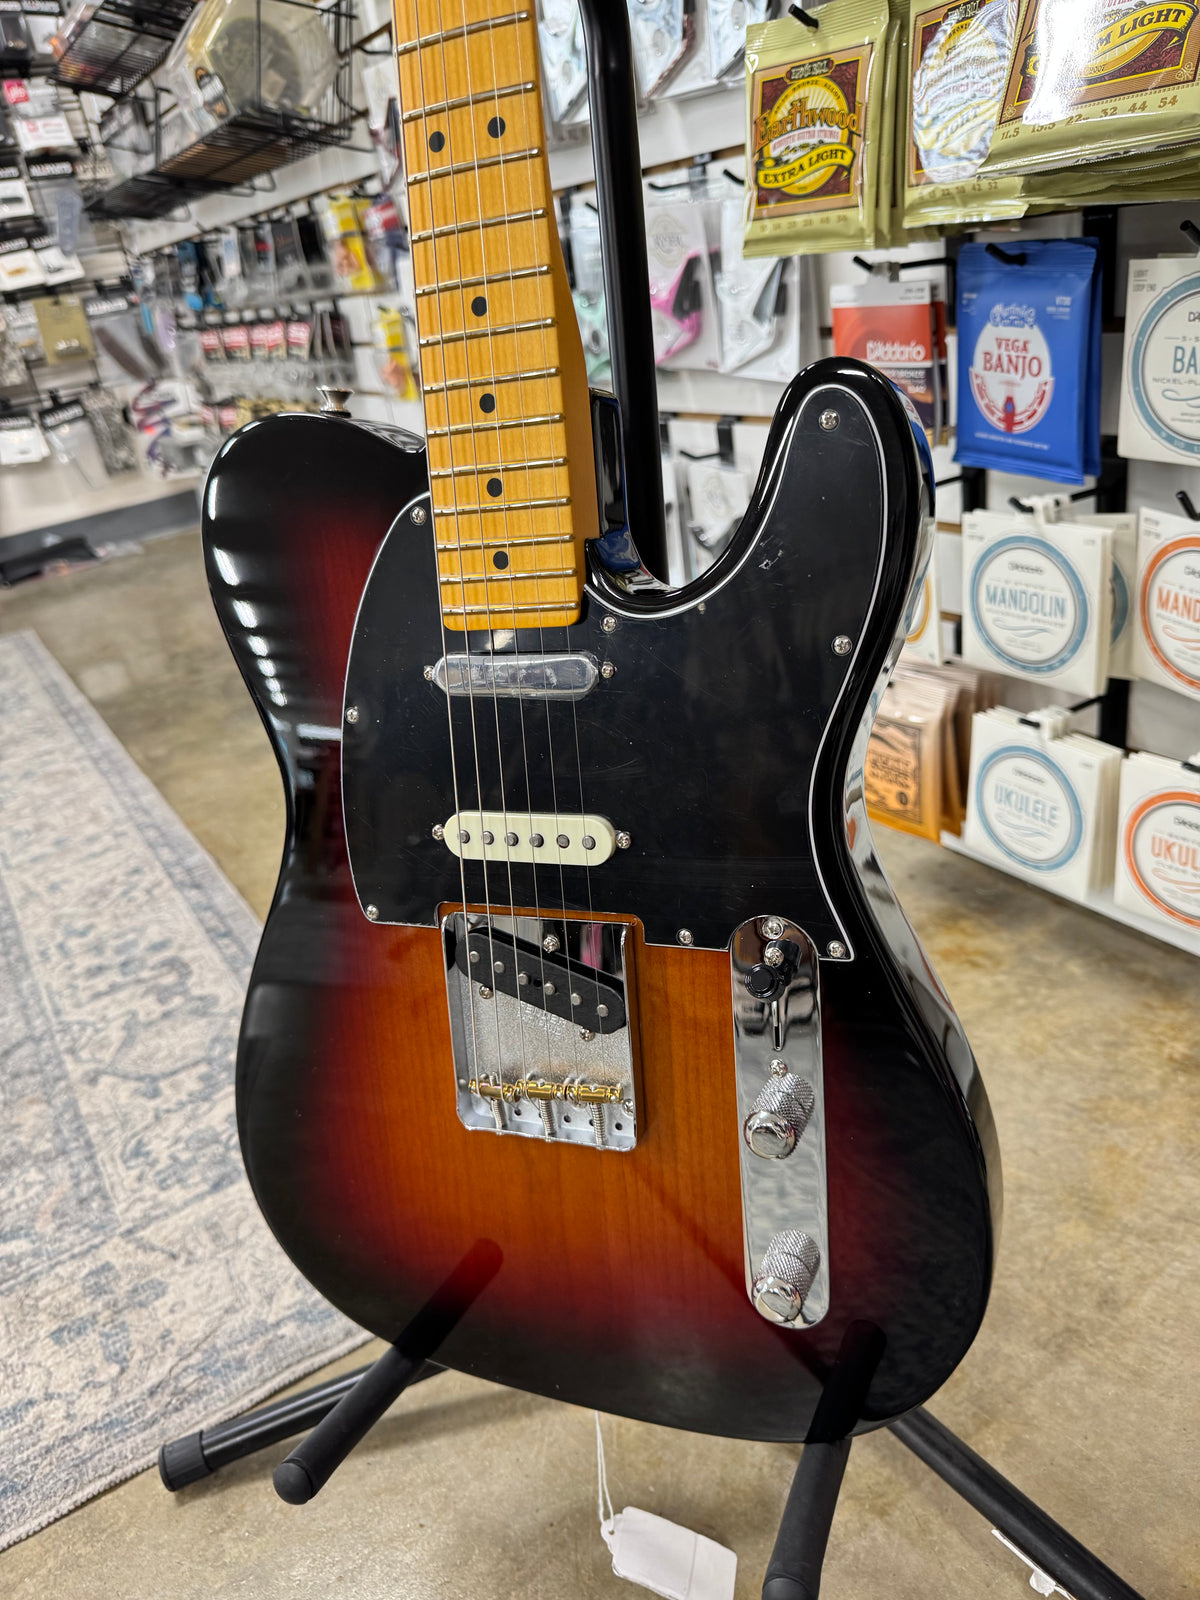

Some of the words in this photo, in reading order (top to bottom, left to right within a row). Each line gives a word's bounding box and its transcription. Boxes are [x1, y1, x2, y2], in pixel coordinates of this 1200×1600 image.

[1117, 8, 1186, 38] LIGHT
[754, 96, 862, 153] Earthwood
[1000, 127, 1020, 141] 11.5
[1127, 100, 1148, 114] 44
[1157, 94, 1179, 109] 54
[763, 164, 805, 184] EXTRA
[808, 148, 848, 168] LIGHT
[995, 337, 1031, 354] VEGA
[983, 351, 1042, 380] BANJO
[985, 584, 1067, 619] MANDOLIN
[994, 783, 1060, 828] UKULELE
